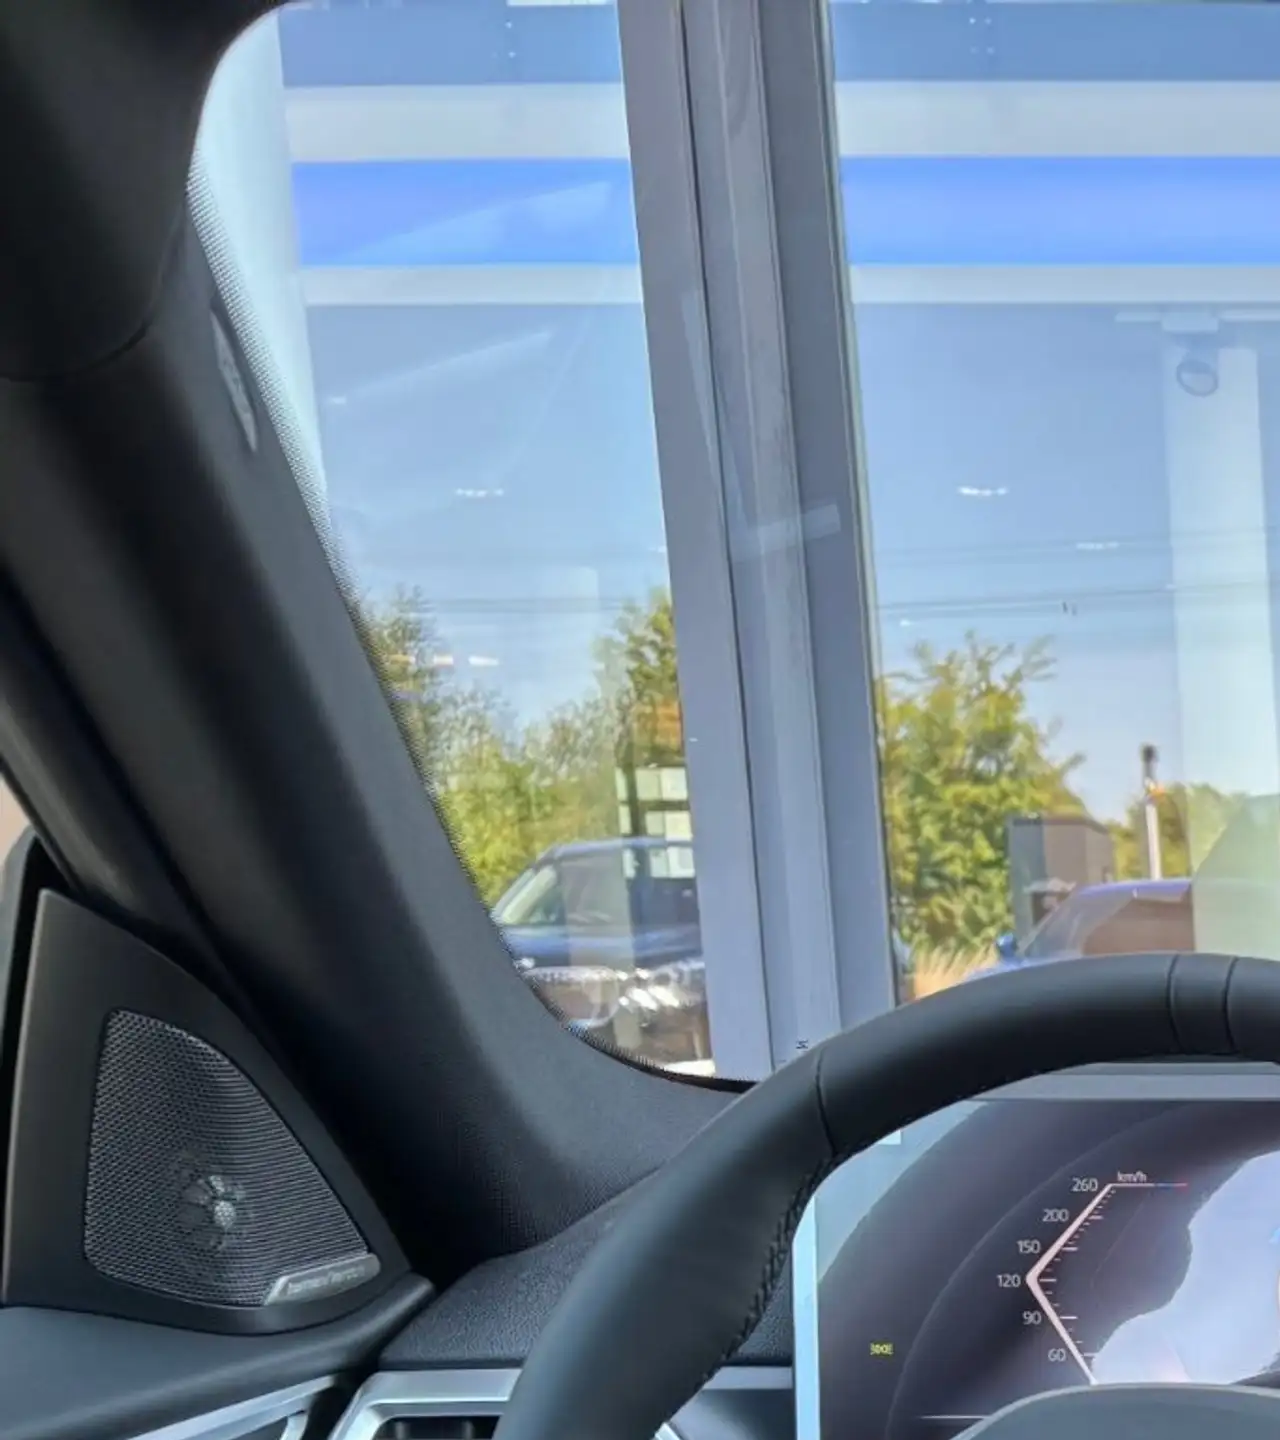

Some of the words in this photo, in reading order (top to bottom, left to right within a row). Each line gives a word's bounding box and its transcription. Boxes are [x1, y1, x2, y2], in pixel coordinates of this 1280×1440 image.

[1117, 1171, 1147, 1182] km/h
[1071, 1178, 1098, 1192] 260
[1042, 1208, 1069, 1222] 200
[1017, 1240, 1040, 1254] 150
[997, 1274, 1021, 1288] 120
[1023, 1311, 1042, 1325] 90
[1048, 1348, 1067, 1362] 60
